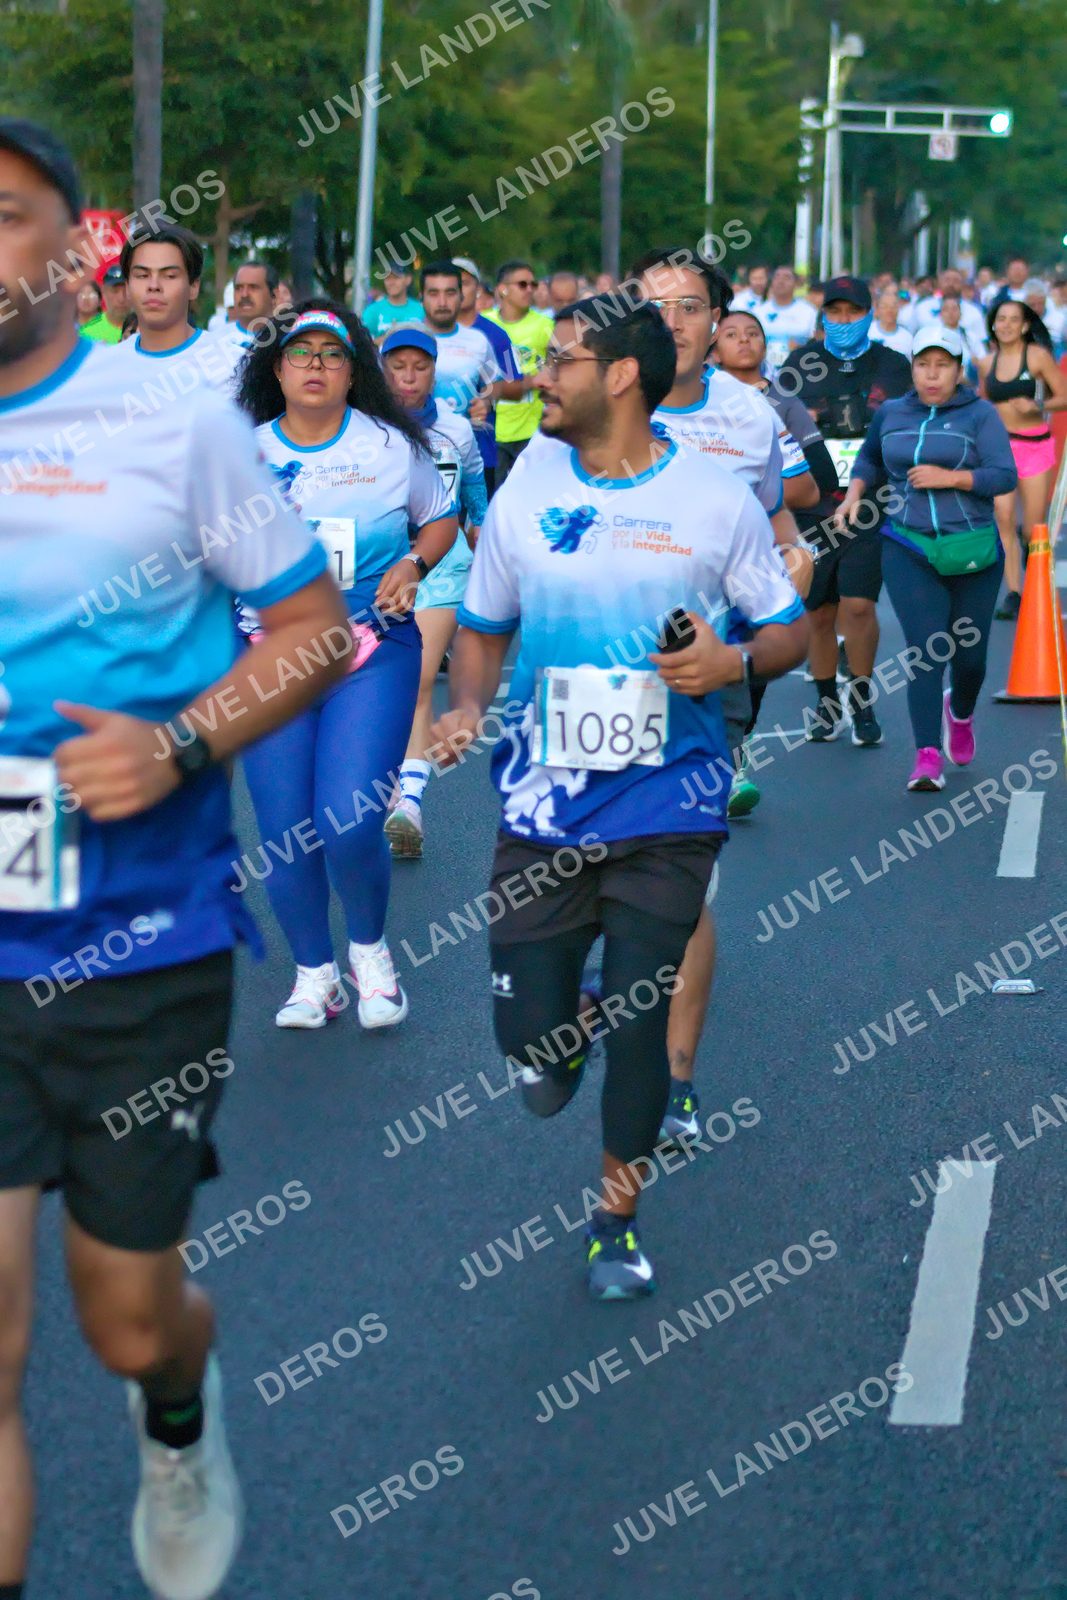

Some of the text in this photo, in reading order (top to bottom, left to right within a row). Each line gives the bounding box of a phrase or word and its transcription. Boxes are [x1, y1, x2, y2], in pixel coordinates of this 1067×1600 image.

[315, 463, 359, 475] Carrera
[341, 471, 360, 480] Vida
[331, 476, 377, 488] Integridad
[612, 515, 672, 532] Carrera
[612, 530, 672, 543] por la Vida
[618, 540, 630, 549] la
[632, 540, 693, 556] Integridad
[555, 711, 663, 756] 1085
[5, 832, 44, 887] 4
